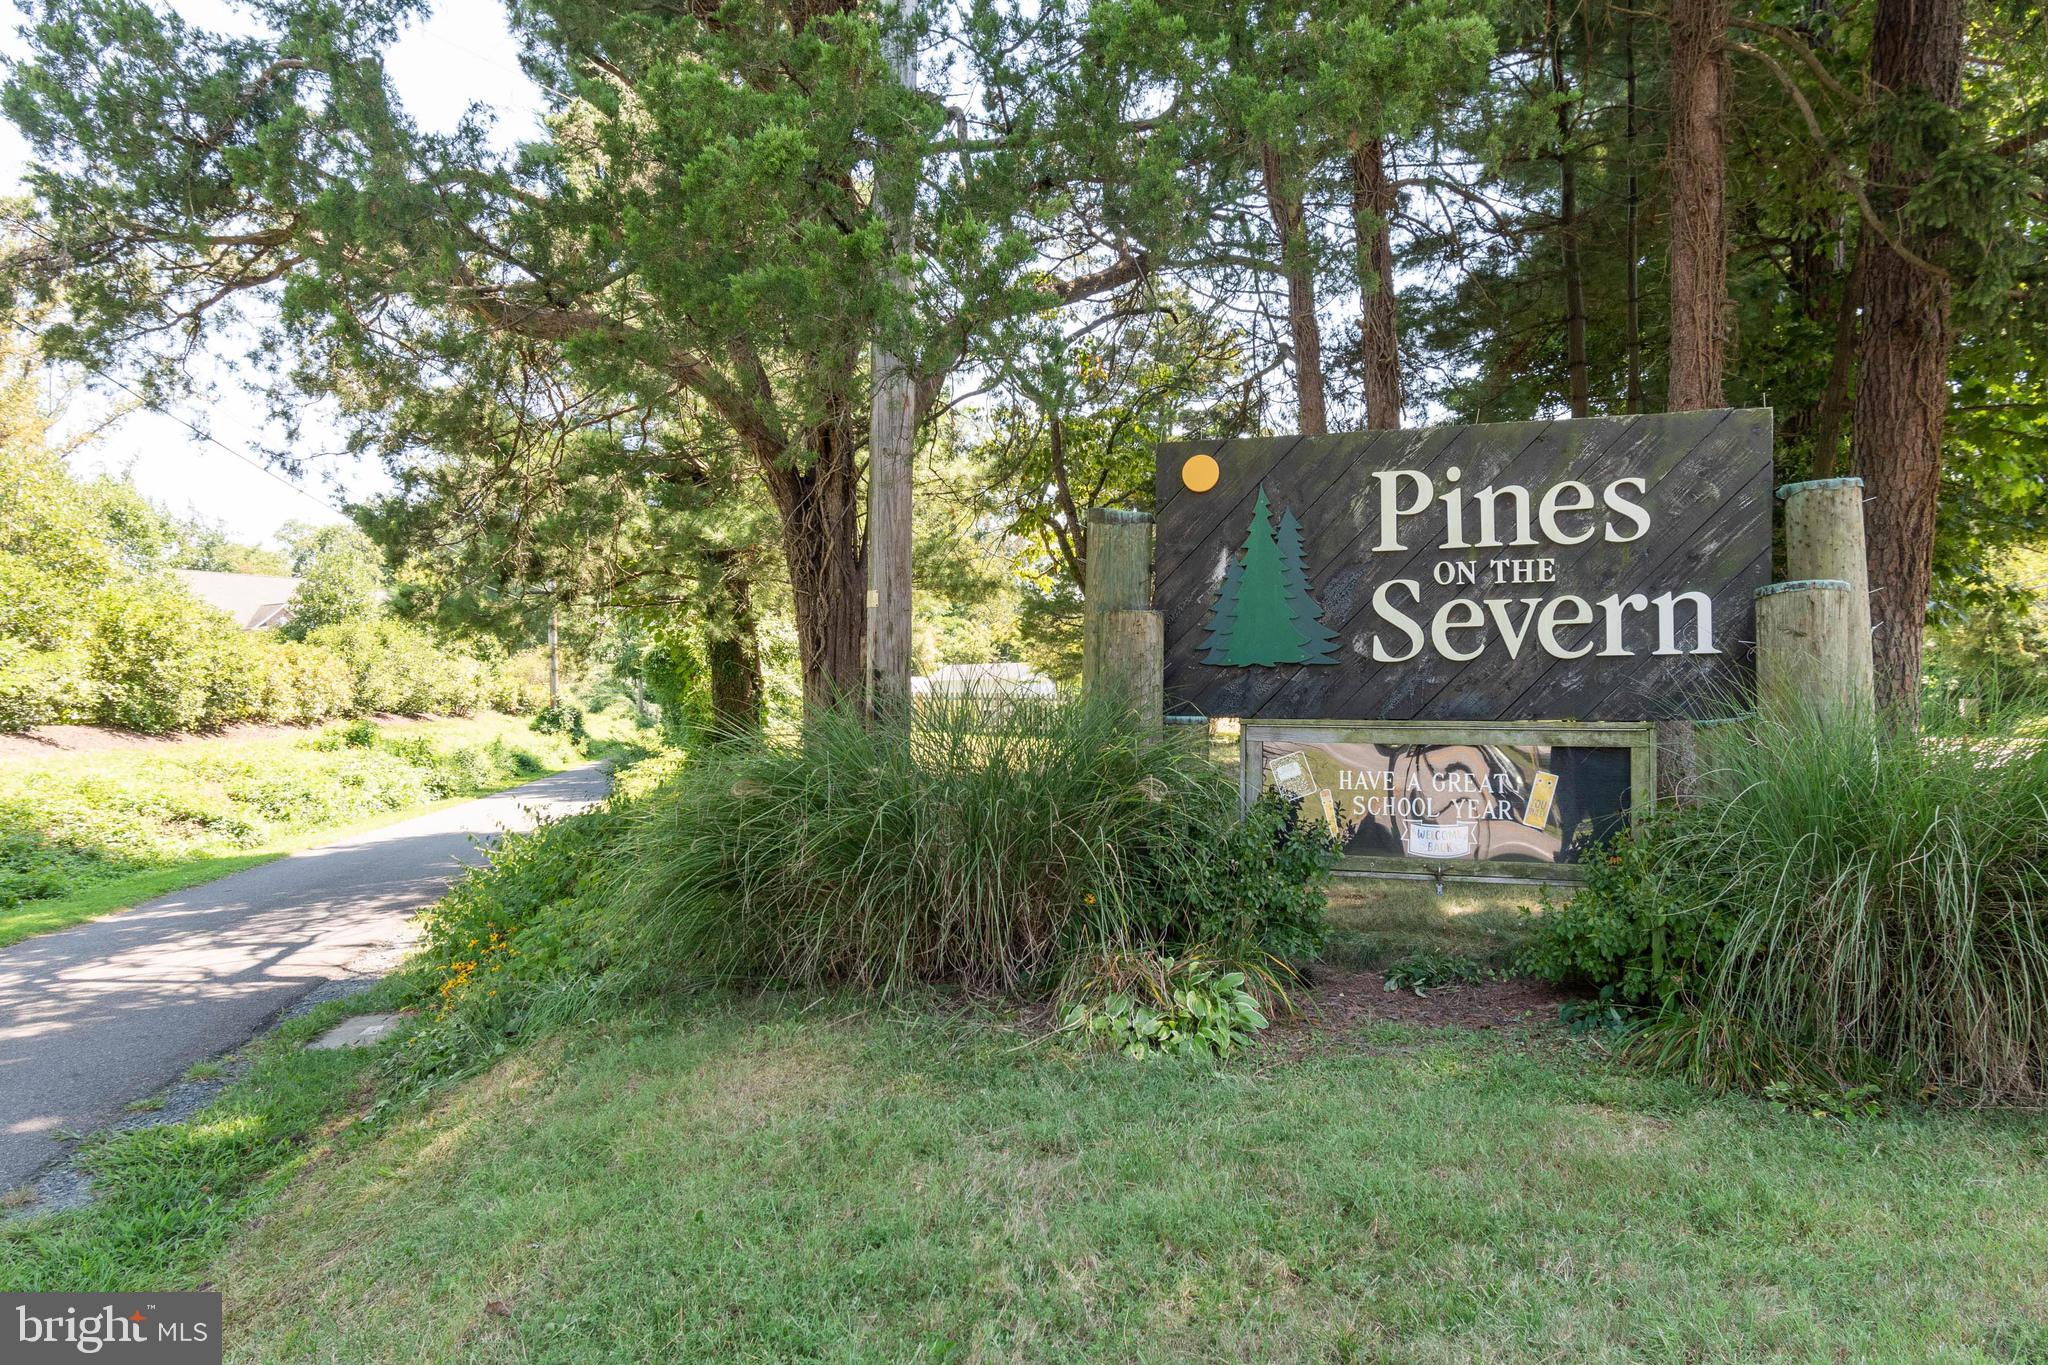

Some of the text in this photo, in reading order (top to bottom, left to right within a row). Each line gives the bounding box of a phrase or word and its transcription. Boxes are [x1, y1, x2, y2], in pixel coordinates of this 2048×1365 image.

[1371, 466, 1651, 552] Pines
[1433, 558, 1556, 586] ON THE
[1372, 579, 1723, 663] Severn
[1338, 770, 1508, 794] HAVE A GREAT
[1352, 796, 1439, 818] SCHOOL
[1454, 799, 1513, 820] YEAR
